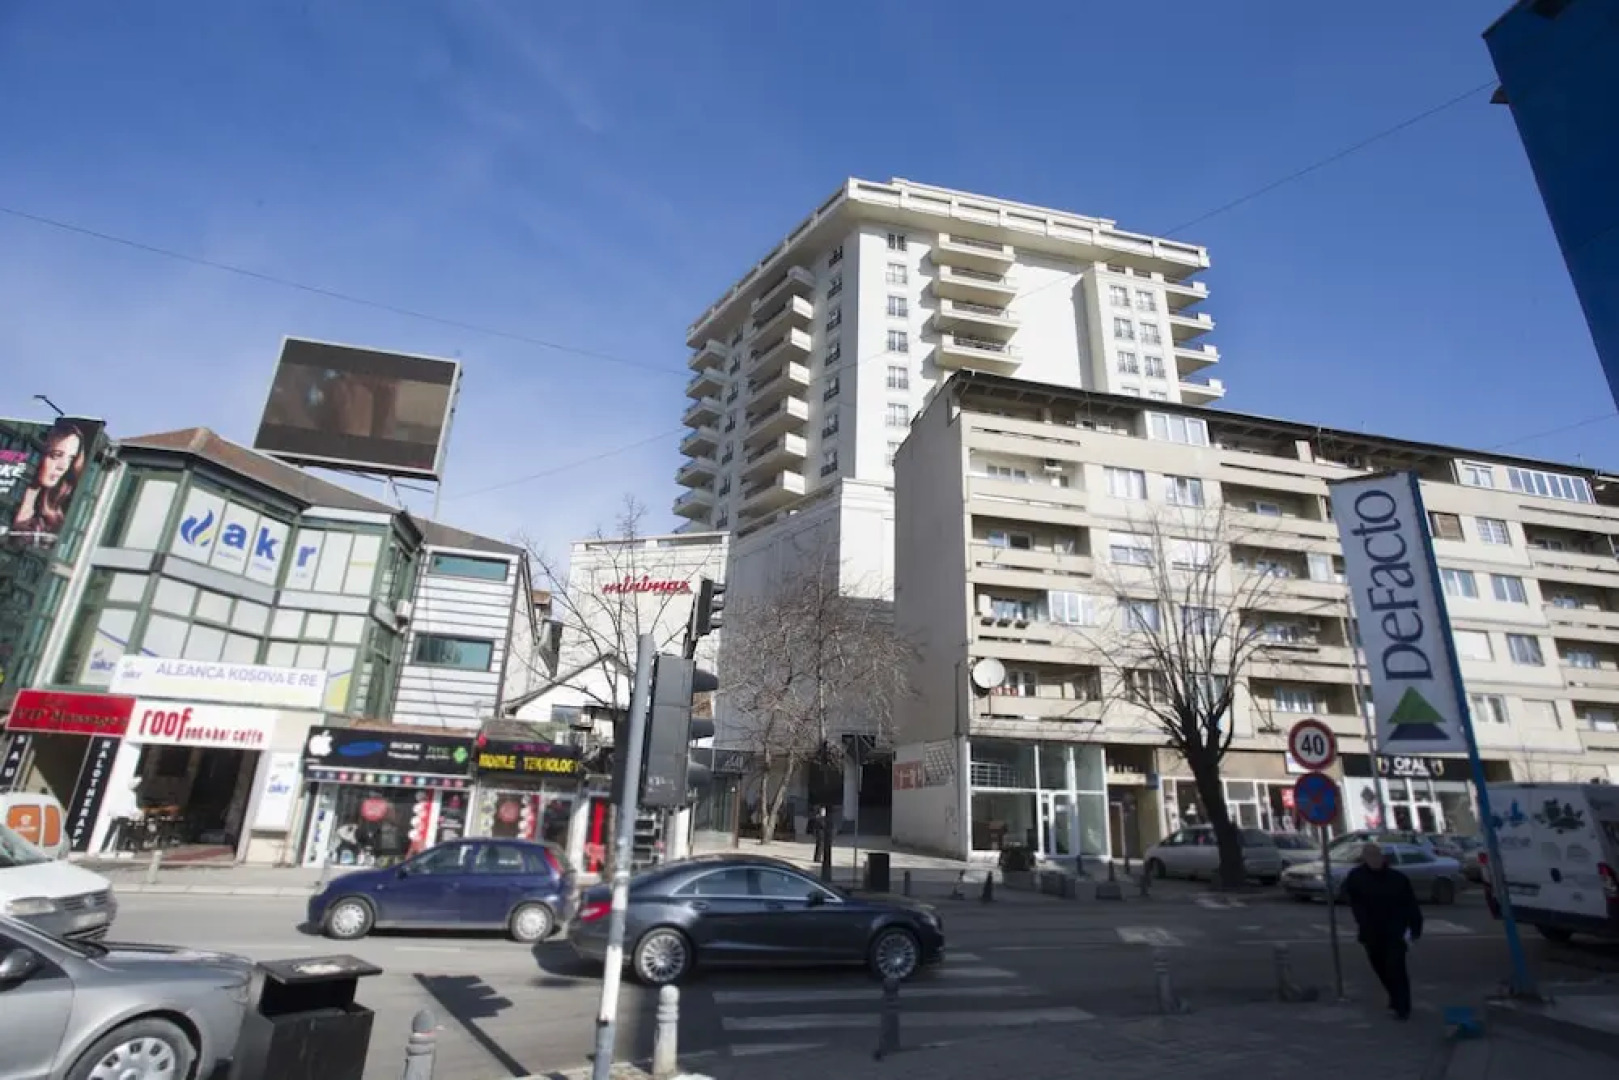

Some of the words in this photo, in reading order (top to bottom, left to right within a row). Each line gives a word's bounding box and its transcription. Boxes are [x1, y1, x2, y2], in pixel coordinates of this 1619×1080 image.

[222, 523, 316, 567] akr
[1352, 490, 1433, 680] DeFacto
[286, 672, 295, 685] E
[298, 673, 318, 687] RE
[139, 707, 194, 741] roof
[1301, 734, 1324, 756] 40
